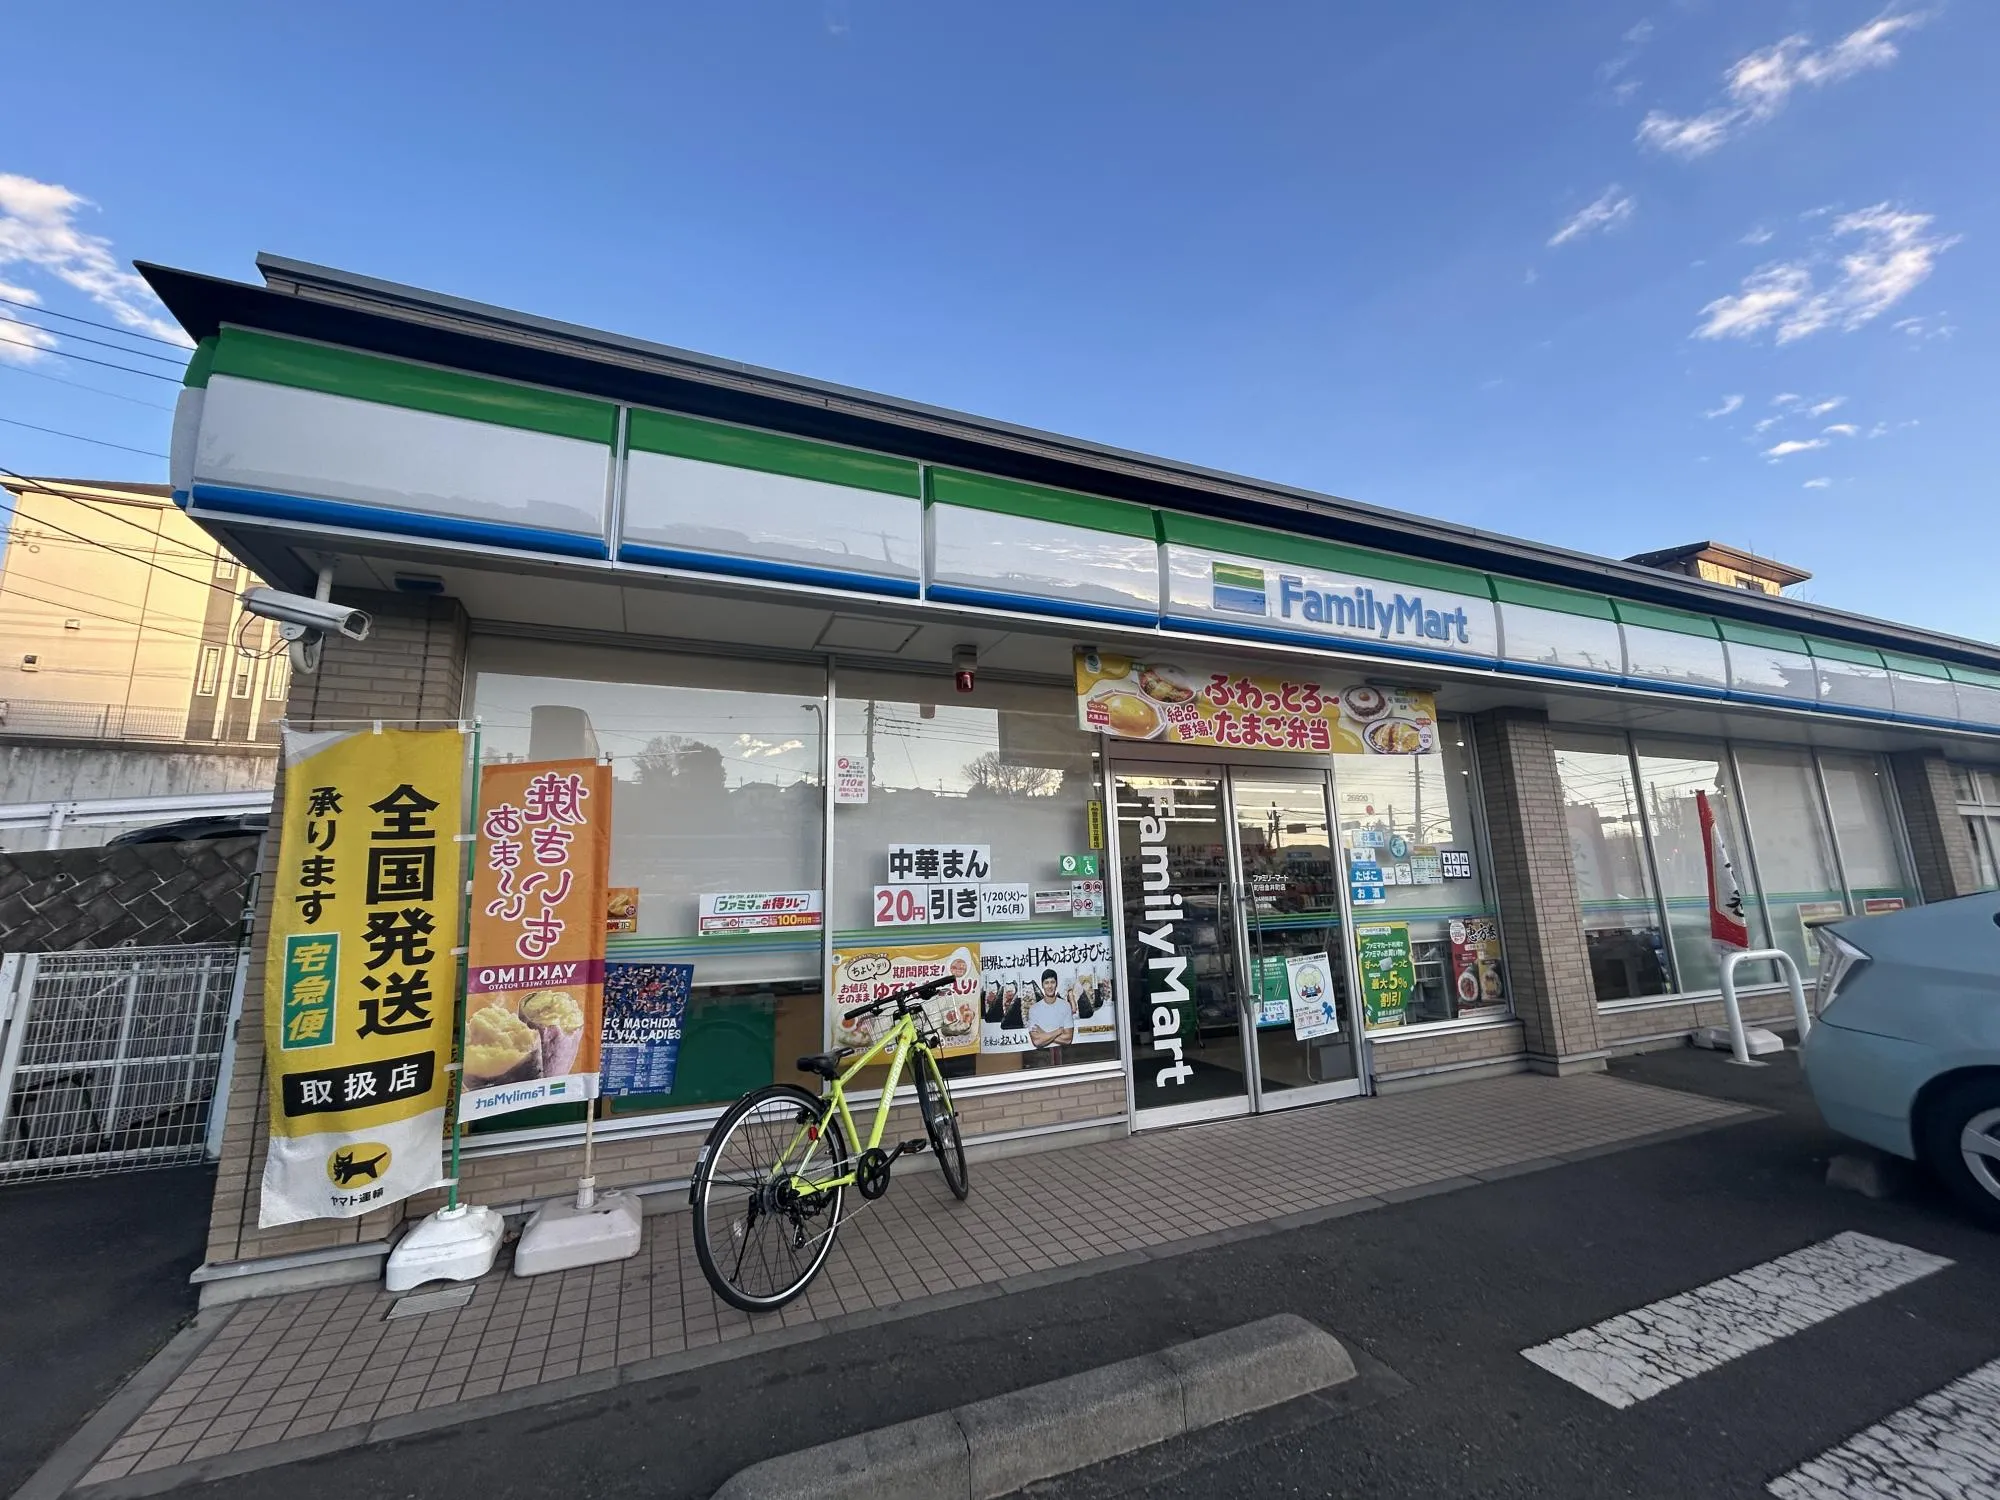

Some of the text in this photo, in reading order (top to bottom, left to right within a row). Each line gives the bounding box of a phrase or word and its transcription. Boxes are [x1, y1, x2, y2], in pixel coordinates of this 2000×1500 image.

[1279, 573, 1469, 644] FamilyMart
[1167, 704, 1199, 723] 絶品
[1214, 710, 1332, 750] たまご弁当
[295, 786, 343, 925] 承ります
[889, 848, 989, 880] 中華まん
[1252, 874, 1289, 882] ファミリーマート
[1355, 870, 1378, 881] たばこ
[359, 783, 440, 1040] 全国発送
[718, 896, 806, 911] ファミマのお得リレー
[1138, 788, 1194, 1088] FamilyMart
[892, 964, 946, 979] 期間限定!
[285, 942, 330, 1042] 宅急便
[840, 982, 869, 994] お値段
[603, 1017, 677, 1029] FC MACHIDA
[601, 1029, 682, 1041] ELVIA LADIES
[300, 1063, 417, 1105] 取扱店
[330, 1187, 384, 1207] ヤマト運輸
